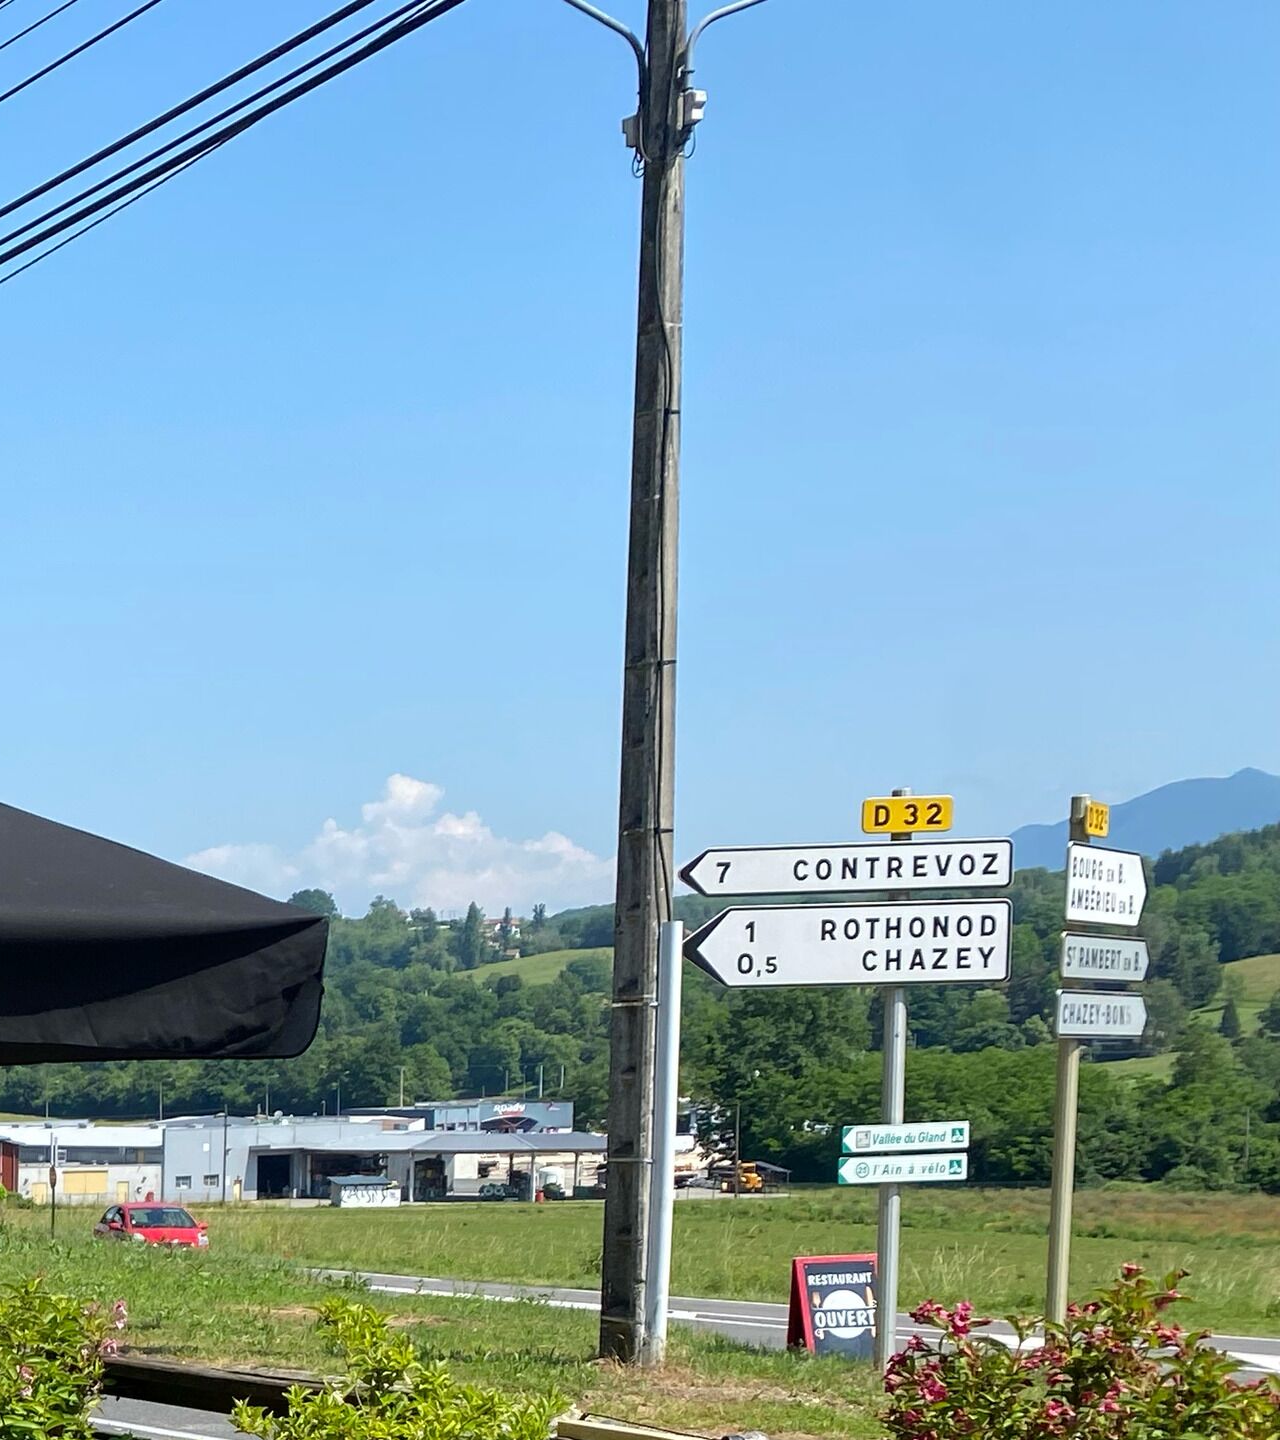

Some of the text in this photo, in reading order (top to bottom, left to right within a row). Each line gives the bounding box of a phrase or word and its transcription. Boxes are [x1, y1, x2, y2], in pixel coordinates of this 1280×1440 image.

[874, 803, 943, 827] D 32
[716, 853, 999, 883] 7 CONTREVOZ
[1072, 856, 1103, 881] BOURG
[1070, 885, 1116, 912] AMBÉRIEU
[744, 914, 997, 943] 1 ROTHONOD
[737, 946, 996, 977] 0,5 CHAZEY
[1078, 947, 1122, 969] RAMBERT
[872, 1131, 947, 1145] Vallée du Gland
[908, 1163, 915, 1174] à
[921, 1162, 947, 1174] vélo
[807, 1272, 872, 1286] RESTAURANT
[814, 1309, 876, 1328] OUVERT
